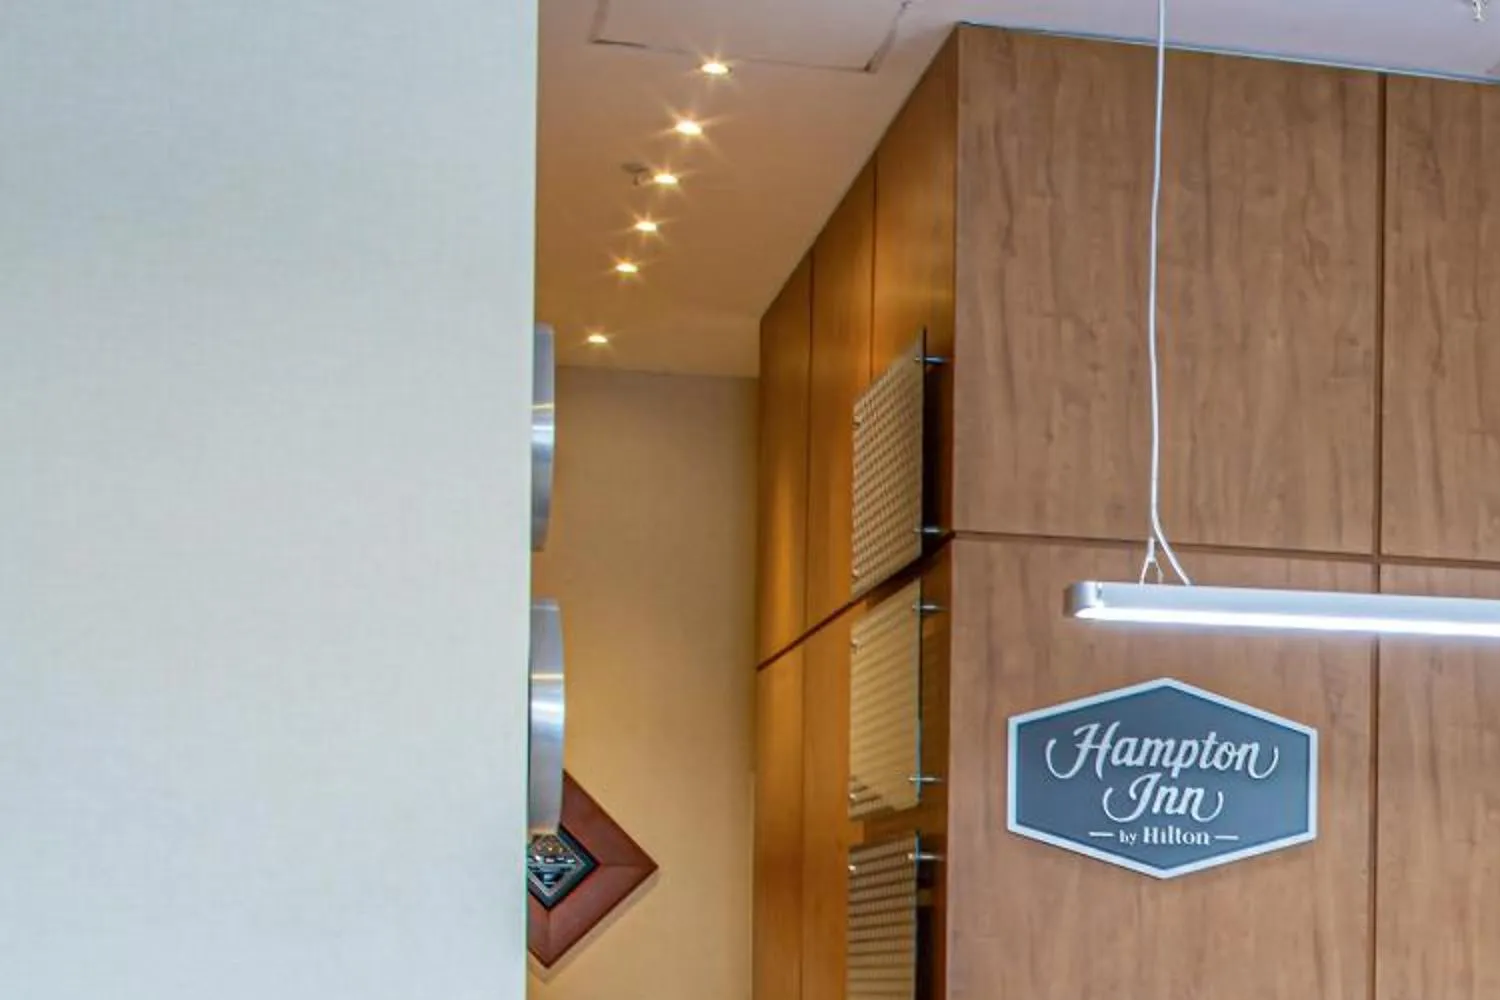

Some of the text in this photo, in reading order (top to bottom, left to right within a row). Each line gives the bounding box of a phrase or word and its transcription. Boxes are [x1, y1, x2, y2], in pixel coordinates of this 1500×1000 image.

[1045, 720, 1279, 781] Hampton
[1102, 773, 1224, 823] Inn
[1118, 826, 1211, 846] by Hilton
